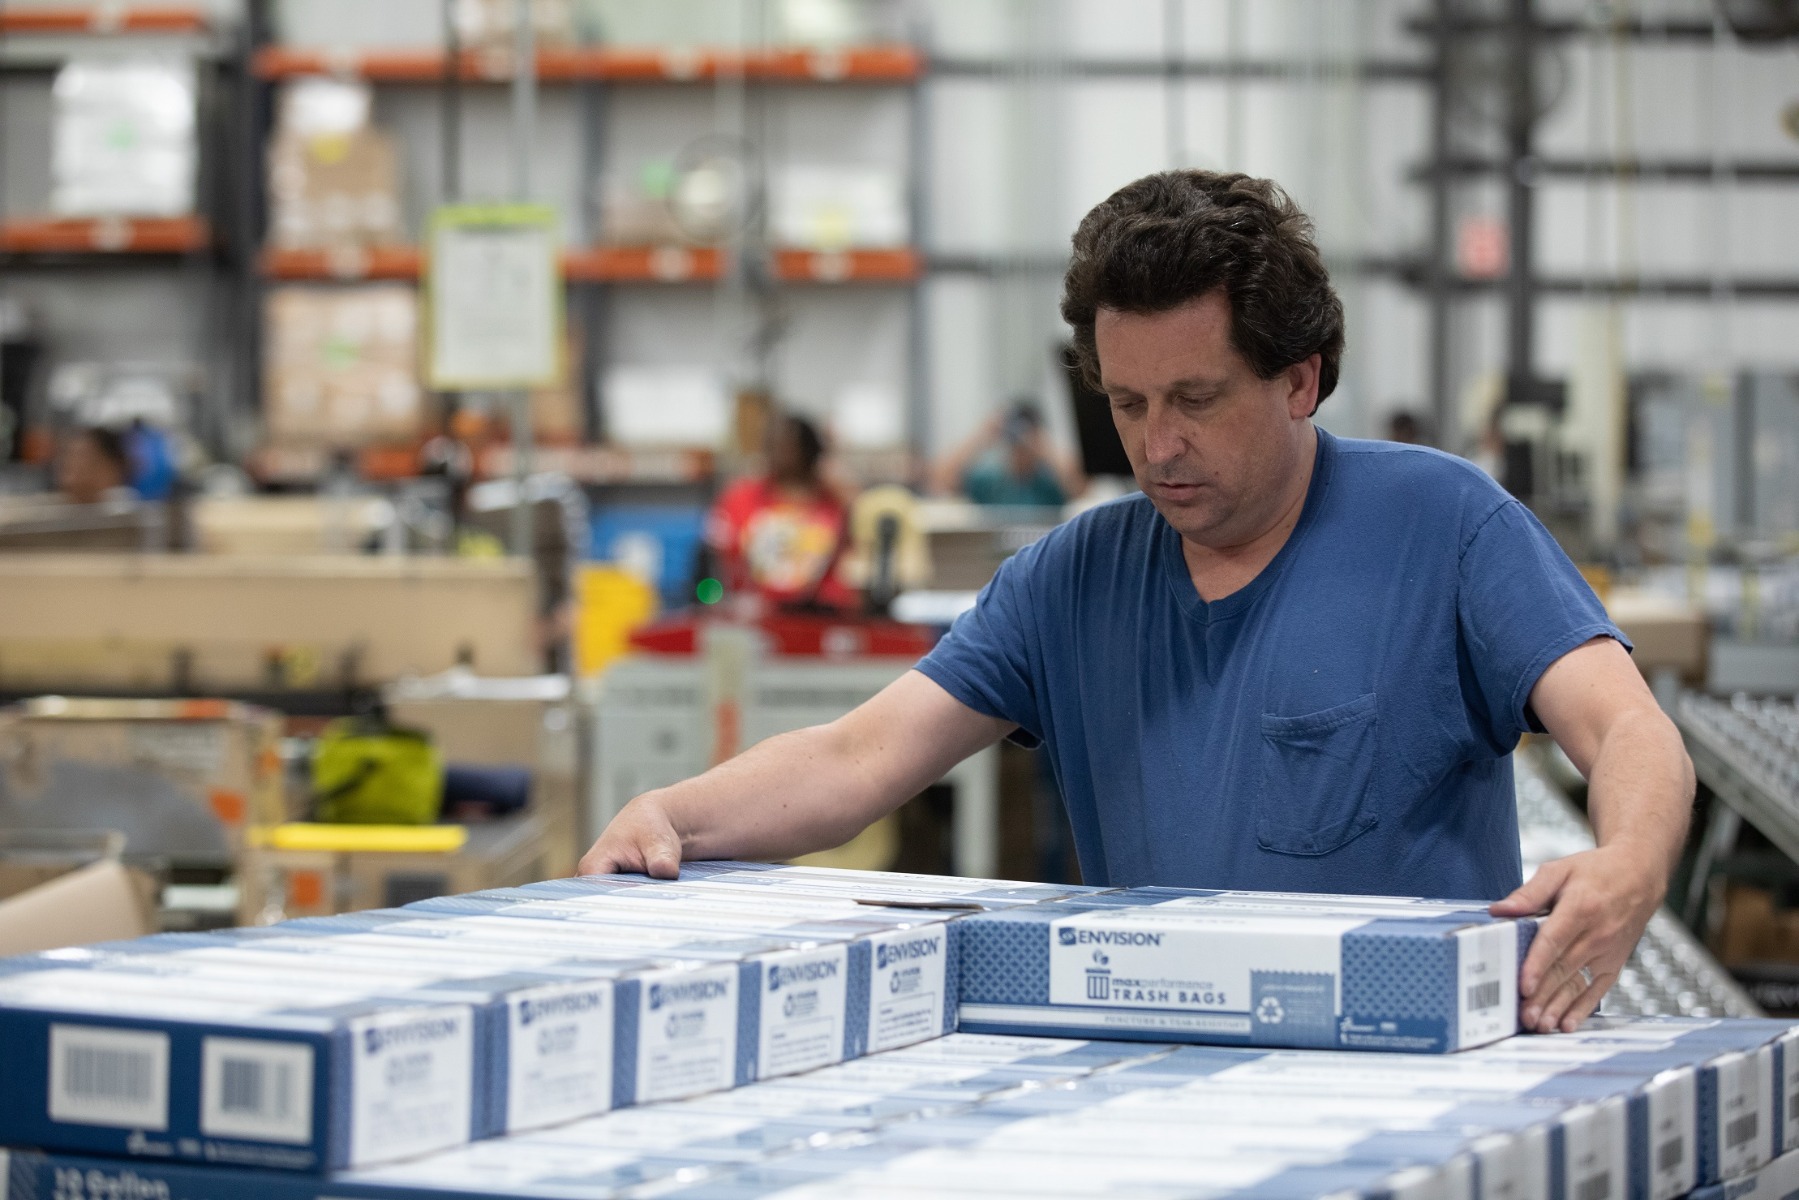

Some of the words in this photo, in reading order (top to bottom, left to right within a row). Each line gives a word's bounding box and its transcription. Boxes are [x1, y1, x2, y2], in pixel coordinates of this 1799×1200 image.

[1078, 930, 1162, 946] ENVISION
[887, 937, 938, 962] ENVISION
[1113, 988, 1169, 1003] TRASH
[1179, 991, 1226, 1005] BAGS
